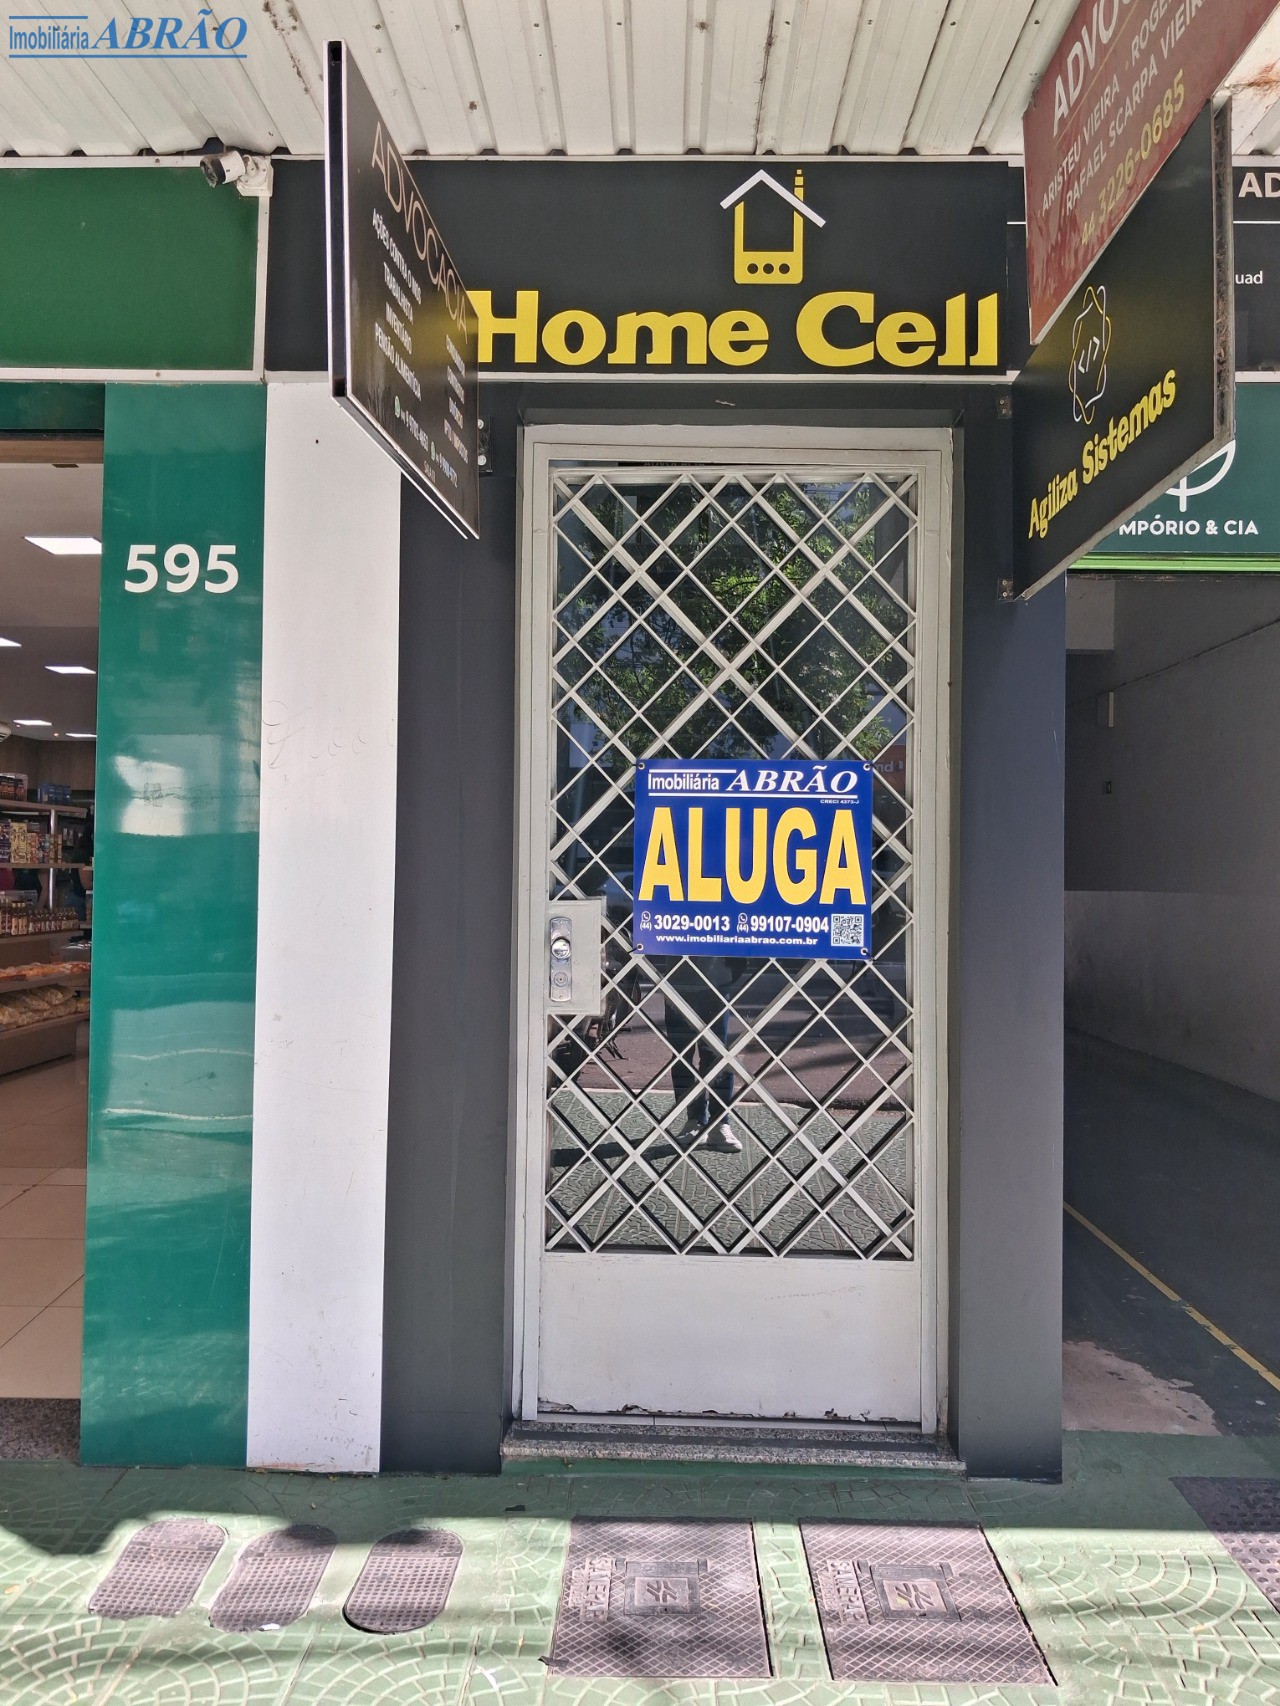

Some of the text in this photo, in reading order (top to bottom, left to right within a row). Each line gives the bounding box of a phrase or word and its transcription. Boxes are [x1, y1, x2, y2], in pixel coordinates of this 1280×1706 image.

[1042, 0, 1172, 217] ARISTEU VIEIRA ROGE
[1053, 0, 1131, 138] ADVO
[1066, 139, 1107, 216] RAFAEL
[1109, 54, 1158, 148] SCARPA
[1098, 68, 1185, 224] 3226-0685
[371, 121, 468, 345] ADVOCACIA
[1235, 270, 1264, 285] uad
[465, 290, 998, 367] Home Cell
[1028, 369, 1176, 539] Agiliza Sistemas
[124, 543, 239, 594] 595
[1119, 514, 1259, 535] MPÓRIO & CIA
[648, 773, 720, 790] Imobiliária
[725, 765, 858, 793] ABRÃO
[638, 806, 867, 905] ALUGA
[640, 914, 829, 933] (44) 3029-0013 (44) 99107-0904
[656, 934, 818, 945] www.imobiliariaabrao.com.br
